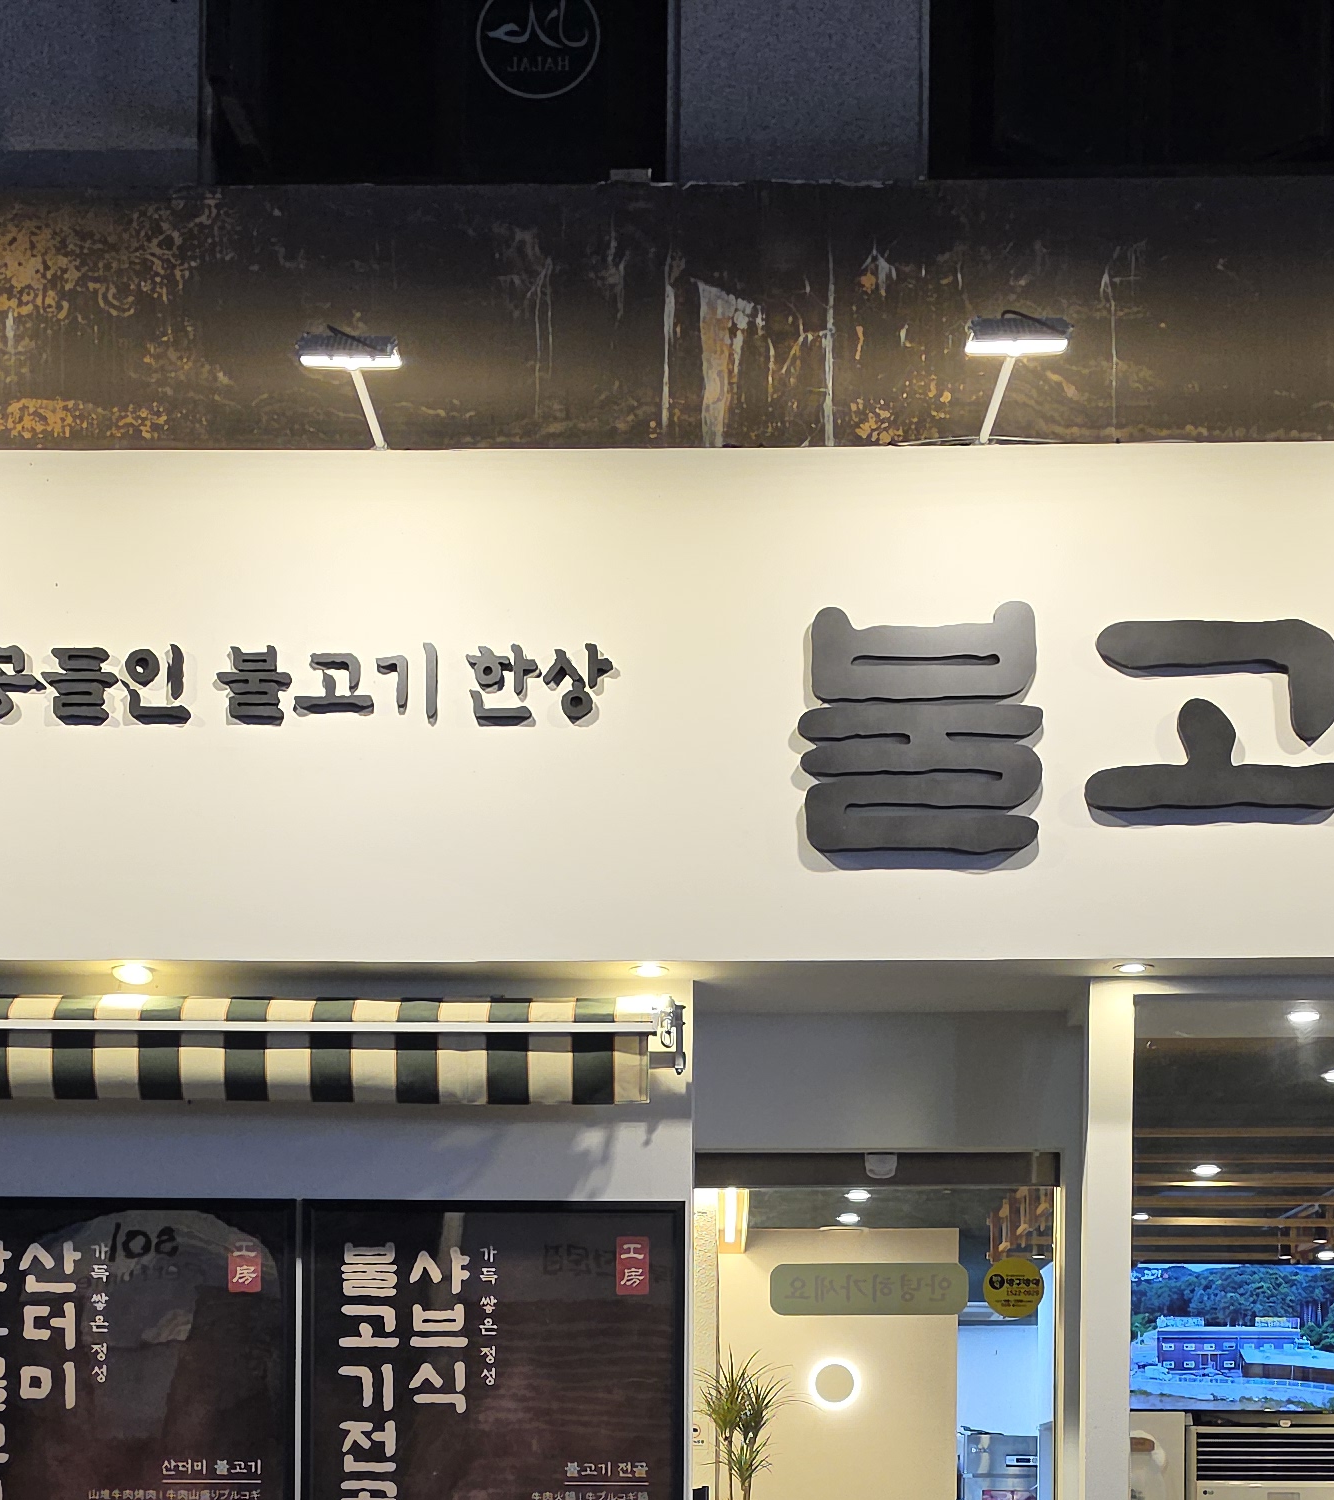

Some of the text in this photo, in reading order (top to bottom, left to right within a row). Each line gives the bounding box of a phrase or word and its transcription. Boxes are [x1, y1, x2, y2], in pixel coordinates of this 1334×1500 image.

[217, 643, 438, 727] 불고기
[467, 643, 614, 727] 한상
[232, 1241, 258, 1286] 工房
[620, 1243, 645, 1288] 工房
[18, 1240, 82, 1410] 산더미
[90, 1243, 109, 1383] 가득 쌓은 정성
[408, 1246, 470, 1414] 샤브식
[479, 1246, 498, 1386] 가득 쌓은 정성
[161, 1459, 262, 1475] 산더미 불고기
[564, 1461, 649, 1478] 불고기 전골
